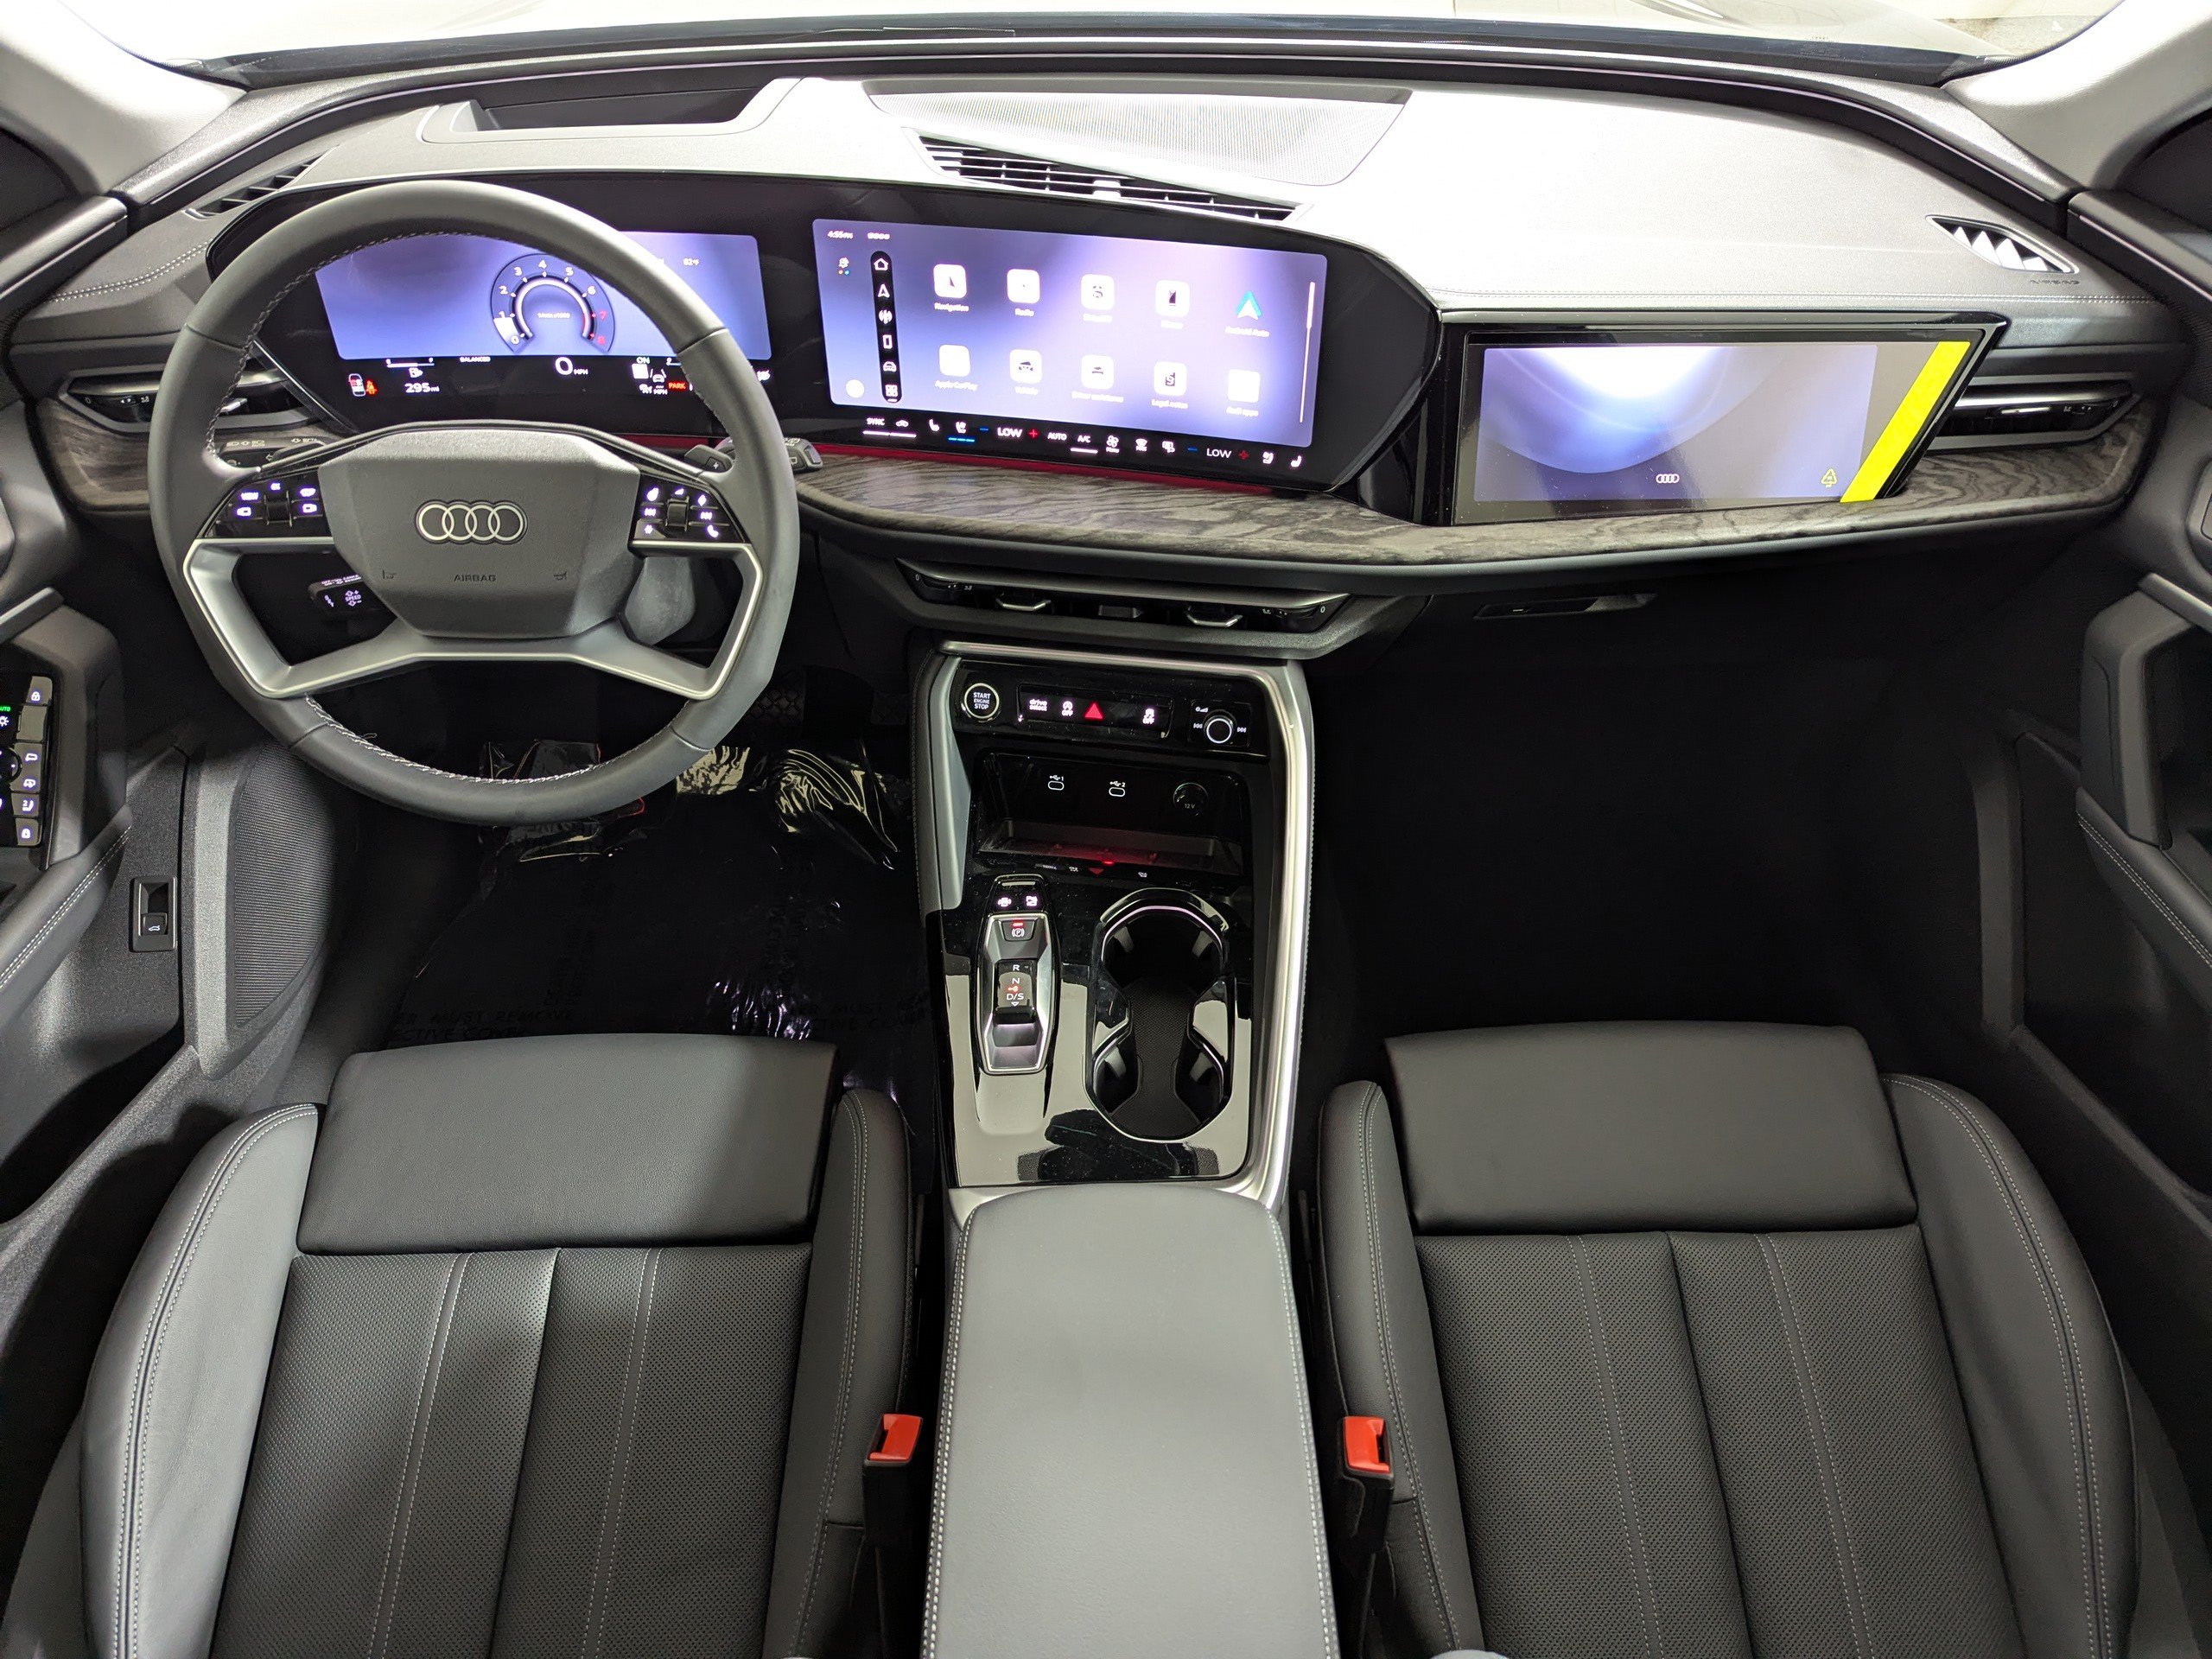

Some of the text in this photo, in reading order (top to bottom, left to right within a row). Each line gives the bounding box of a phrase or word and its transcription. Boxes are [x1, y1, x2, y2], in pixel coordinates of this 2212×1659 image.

[537, 259, 547, 269] 4
[513, 266, 523, 276] 3
[565, 266, 574, 276] 5
[499, 285, 508, 295] 2
[588, 285, 596, 296] 6
[600, 310, 607, 321] 7
[511, 335, 519, 345] 0
[597, 335, 606, 345] 8
[555, 356, 574, 376] 0
[404, 383, 430, 393] 295
[866, 417, 886, 426] SYNC
[997, 427, 1023, 438] LOW
[1047, 432, 1067, 441] AUTO
[1077, 435, 1091, 443] A/C
[1206, 448, 1232, 459] LOW
[454, 574, 496, 582] AIRBAG
